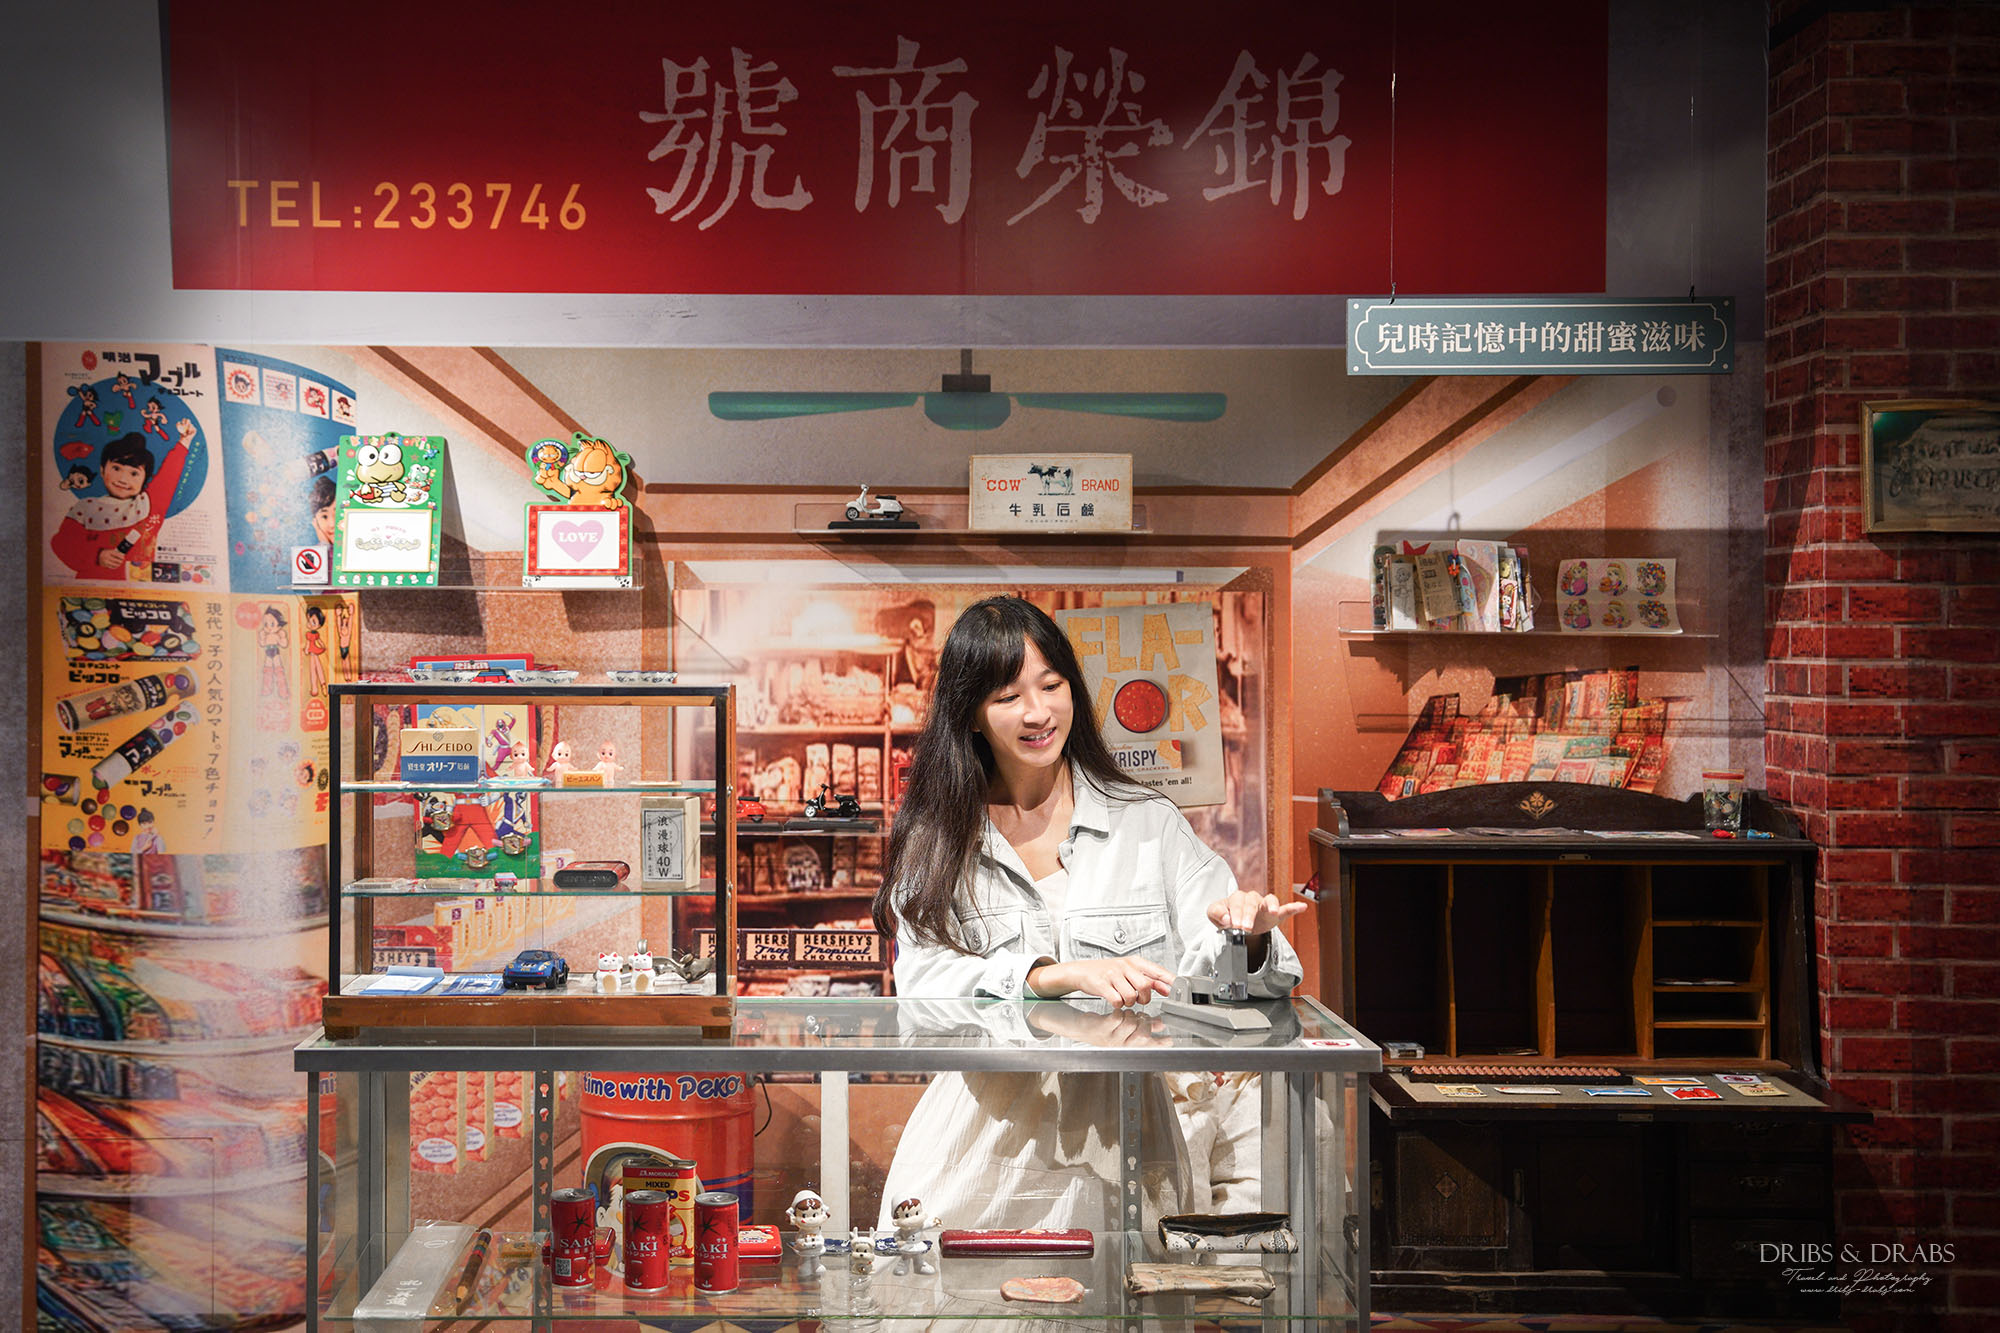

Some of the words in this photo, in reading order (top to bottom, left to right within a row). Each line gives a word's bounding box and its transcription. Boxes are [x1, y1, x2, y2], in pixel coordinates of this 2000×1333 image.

[1374, 319, 1707, 354] 兒時記憶中的甜蜜滋味
[133, 352, 202, 387] マーブル
[1081, 478, 1120, 492] BRAND
[558, 531, 599, 543] LOVE
[407, 741, 473, 753] SHISEIDO
[1181, 777, 1192, 785] all!
[803, 934, 873, 946] HERSHEY'S
[803, 945, 871, 956] Tropical
[583, 1073, 616, 1097] time
[619, 1077, 673, 1101] with
[645, 1181, 671, 1189] MIXED
[559, 1237, 593, 1248] SAK
